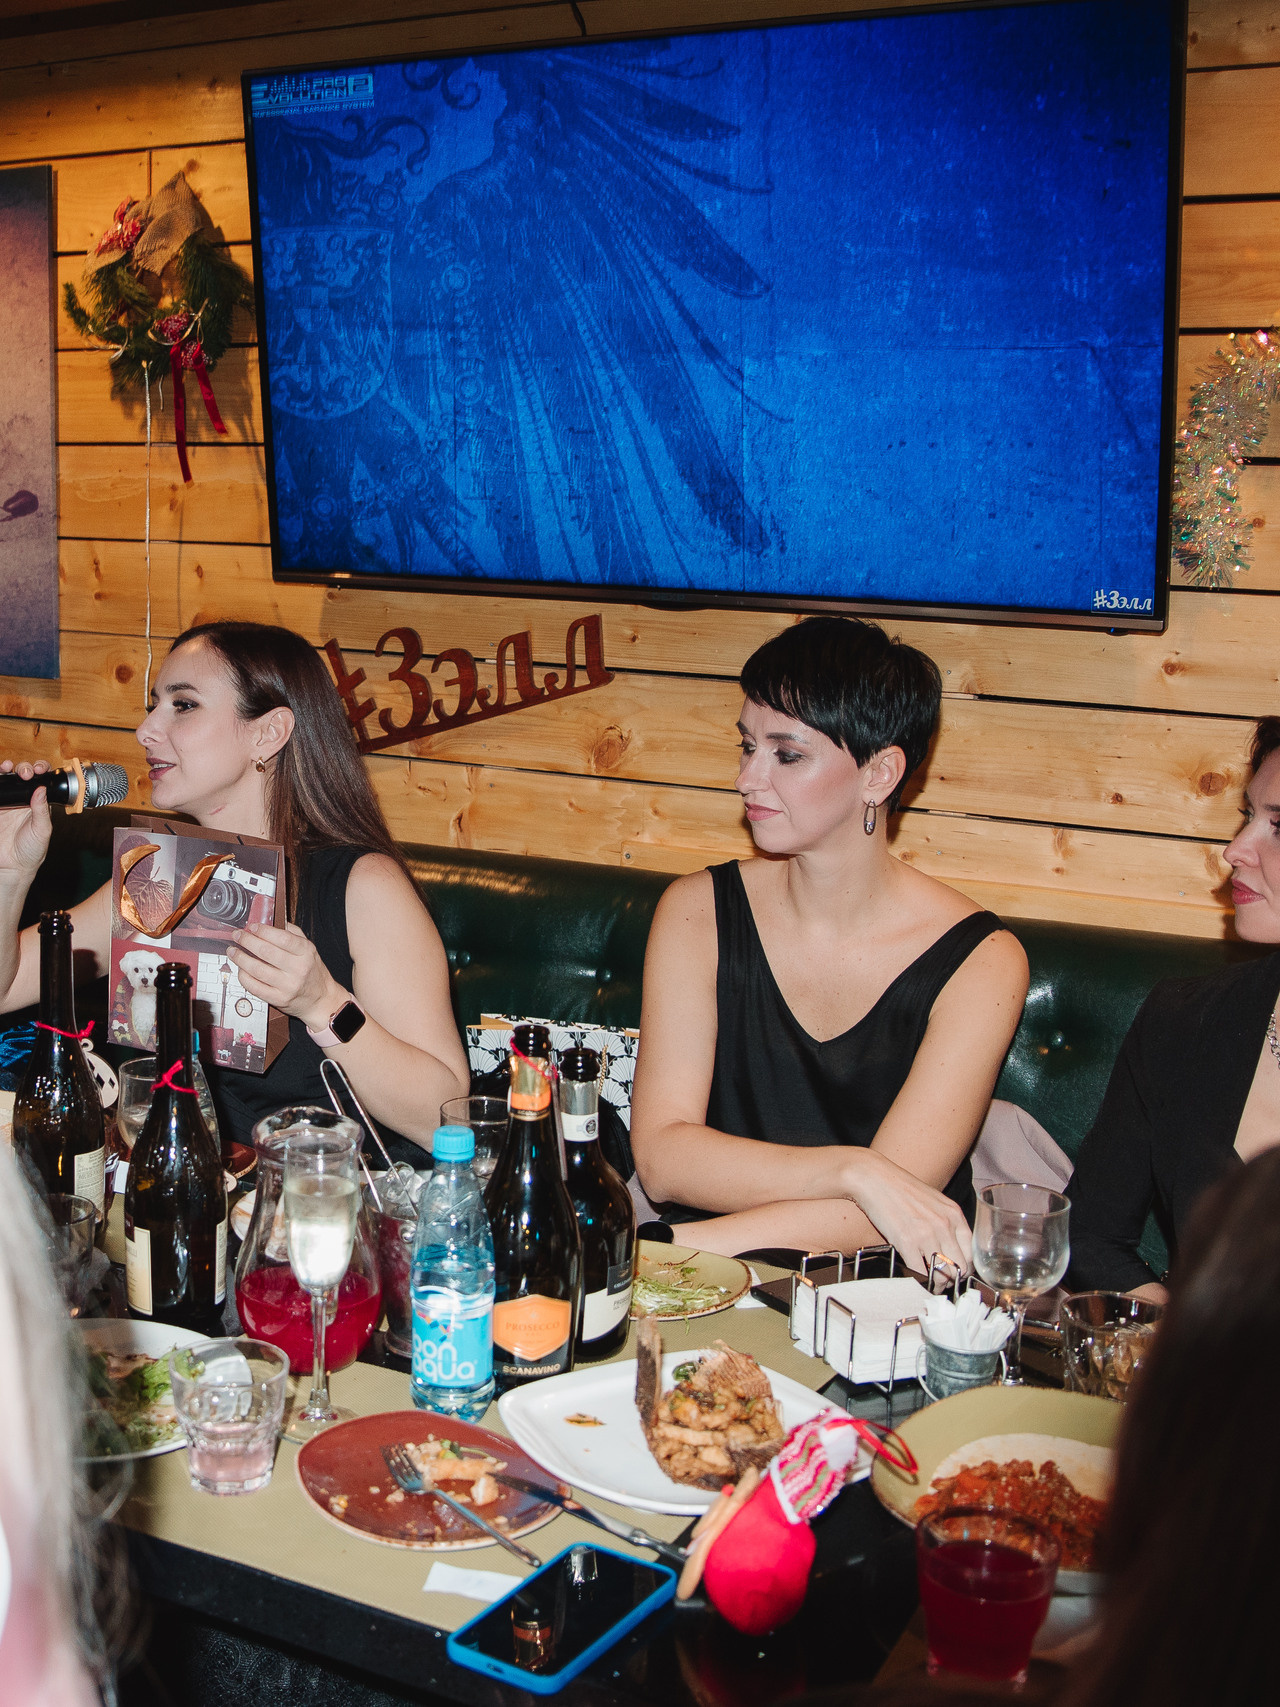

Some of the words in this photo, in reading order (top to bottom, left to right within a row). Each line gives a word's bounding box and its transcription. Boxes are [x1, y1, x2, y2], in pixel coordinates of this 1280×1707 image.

[342, 99, 375, 111] SYSTEM
[505, 1320, 561, 1332] PROSECCO
[412, 1353, 476, 1383] aqua
[502, 1363, 562, 1375] SCANAVINO
